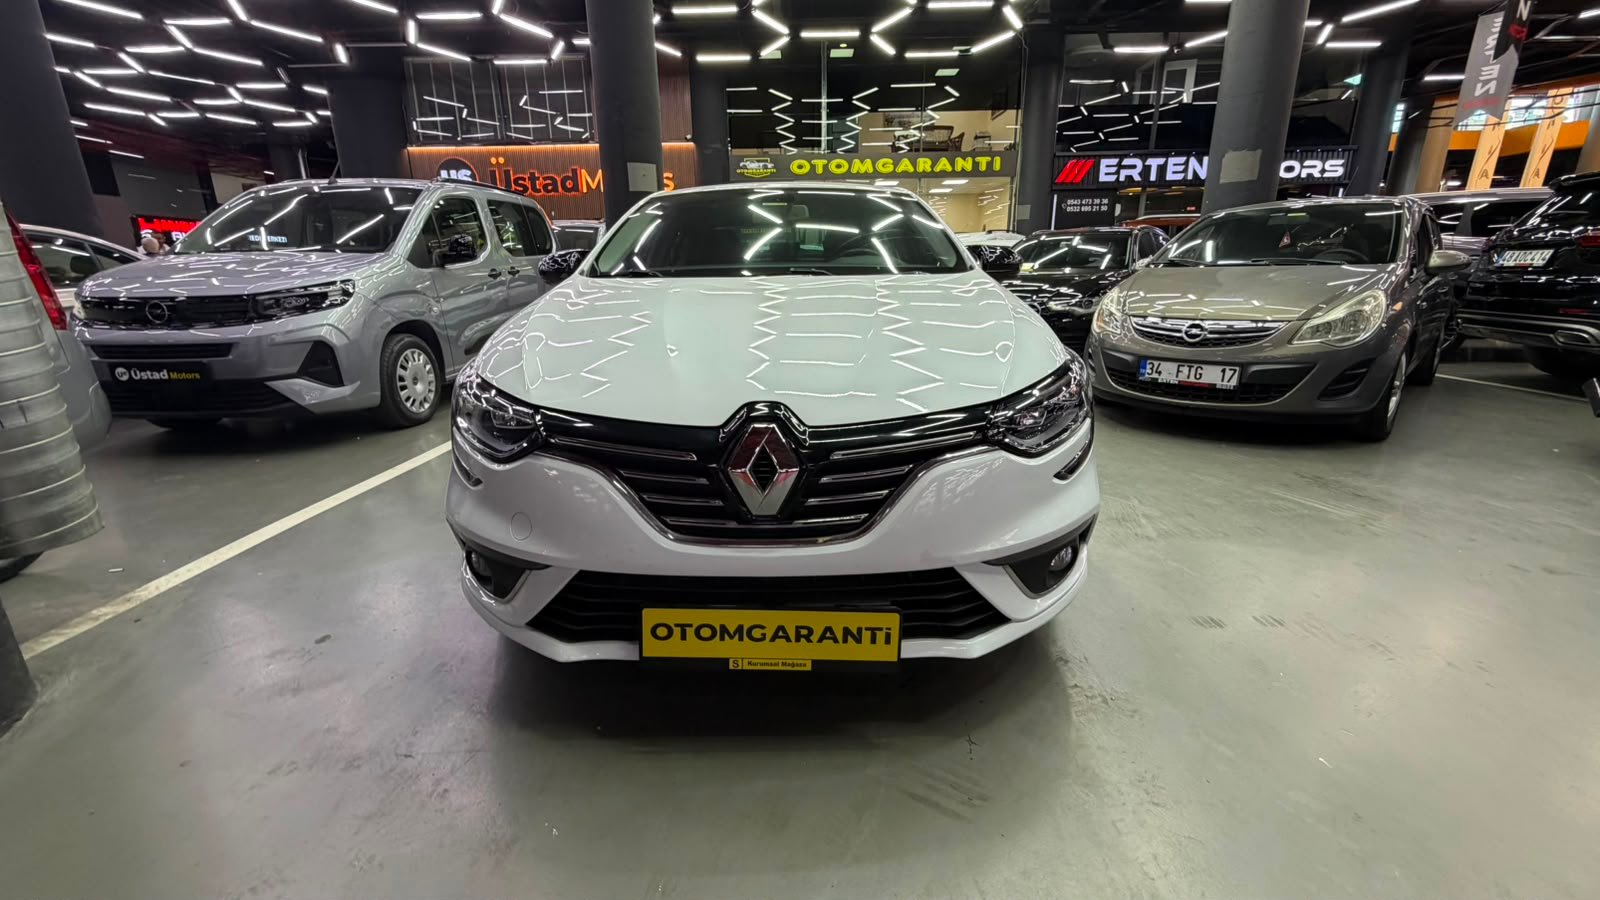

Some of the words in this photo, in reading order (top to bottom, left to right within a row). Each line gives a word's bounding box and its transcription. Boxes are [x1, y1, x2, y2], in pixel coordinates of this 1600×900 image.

[790, 156, 1001, 175] OTOMGARANTI
[1099, 156, 1209, 182] ERTEN
[1278, 159, 1345, 178] ORS
[130, 367, 169, 380] Üstad
[1146, 361, 1162, 377] 34
[1175, 364, 1203, 381] FTG
[1220, 367, 1238, 383] 17
